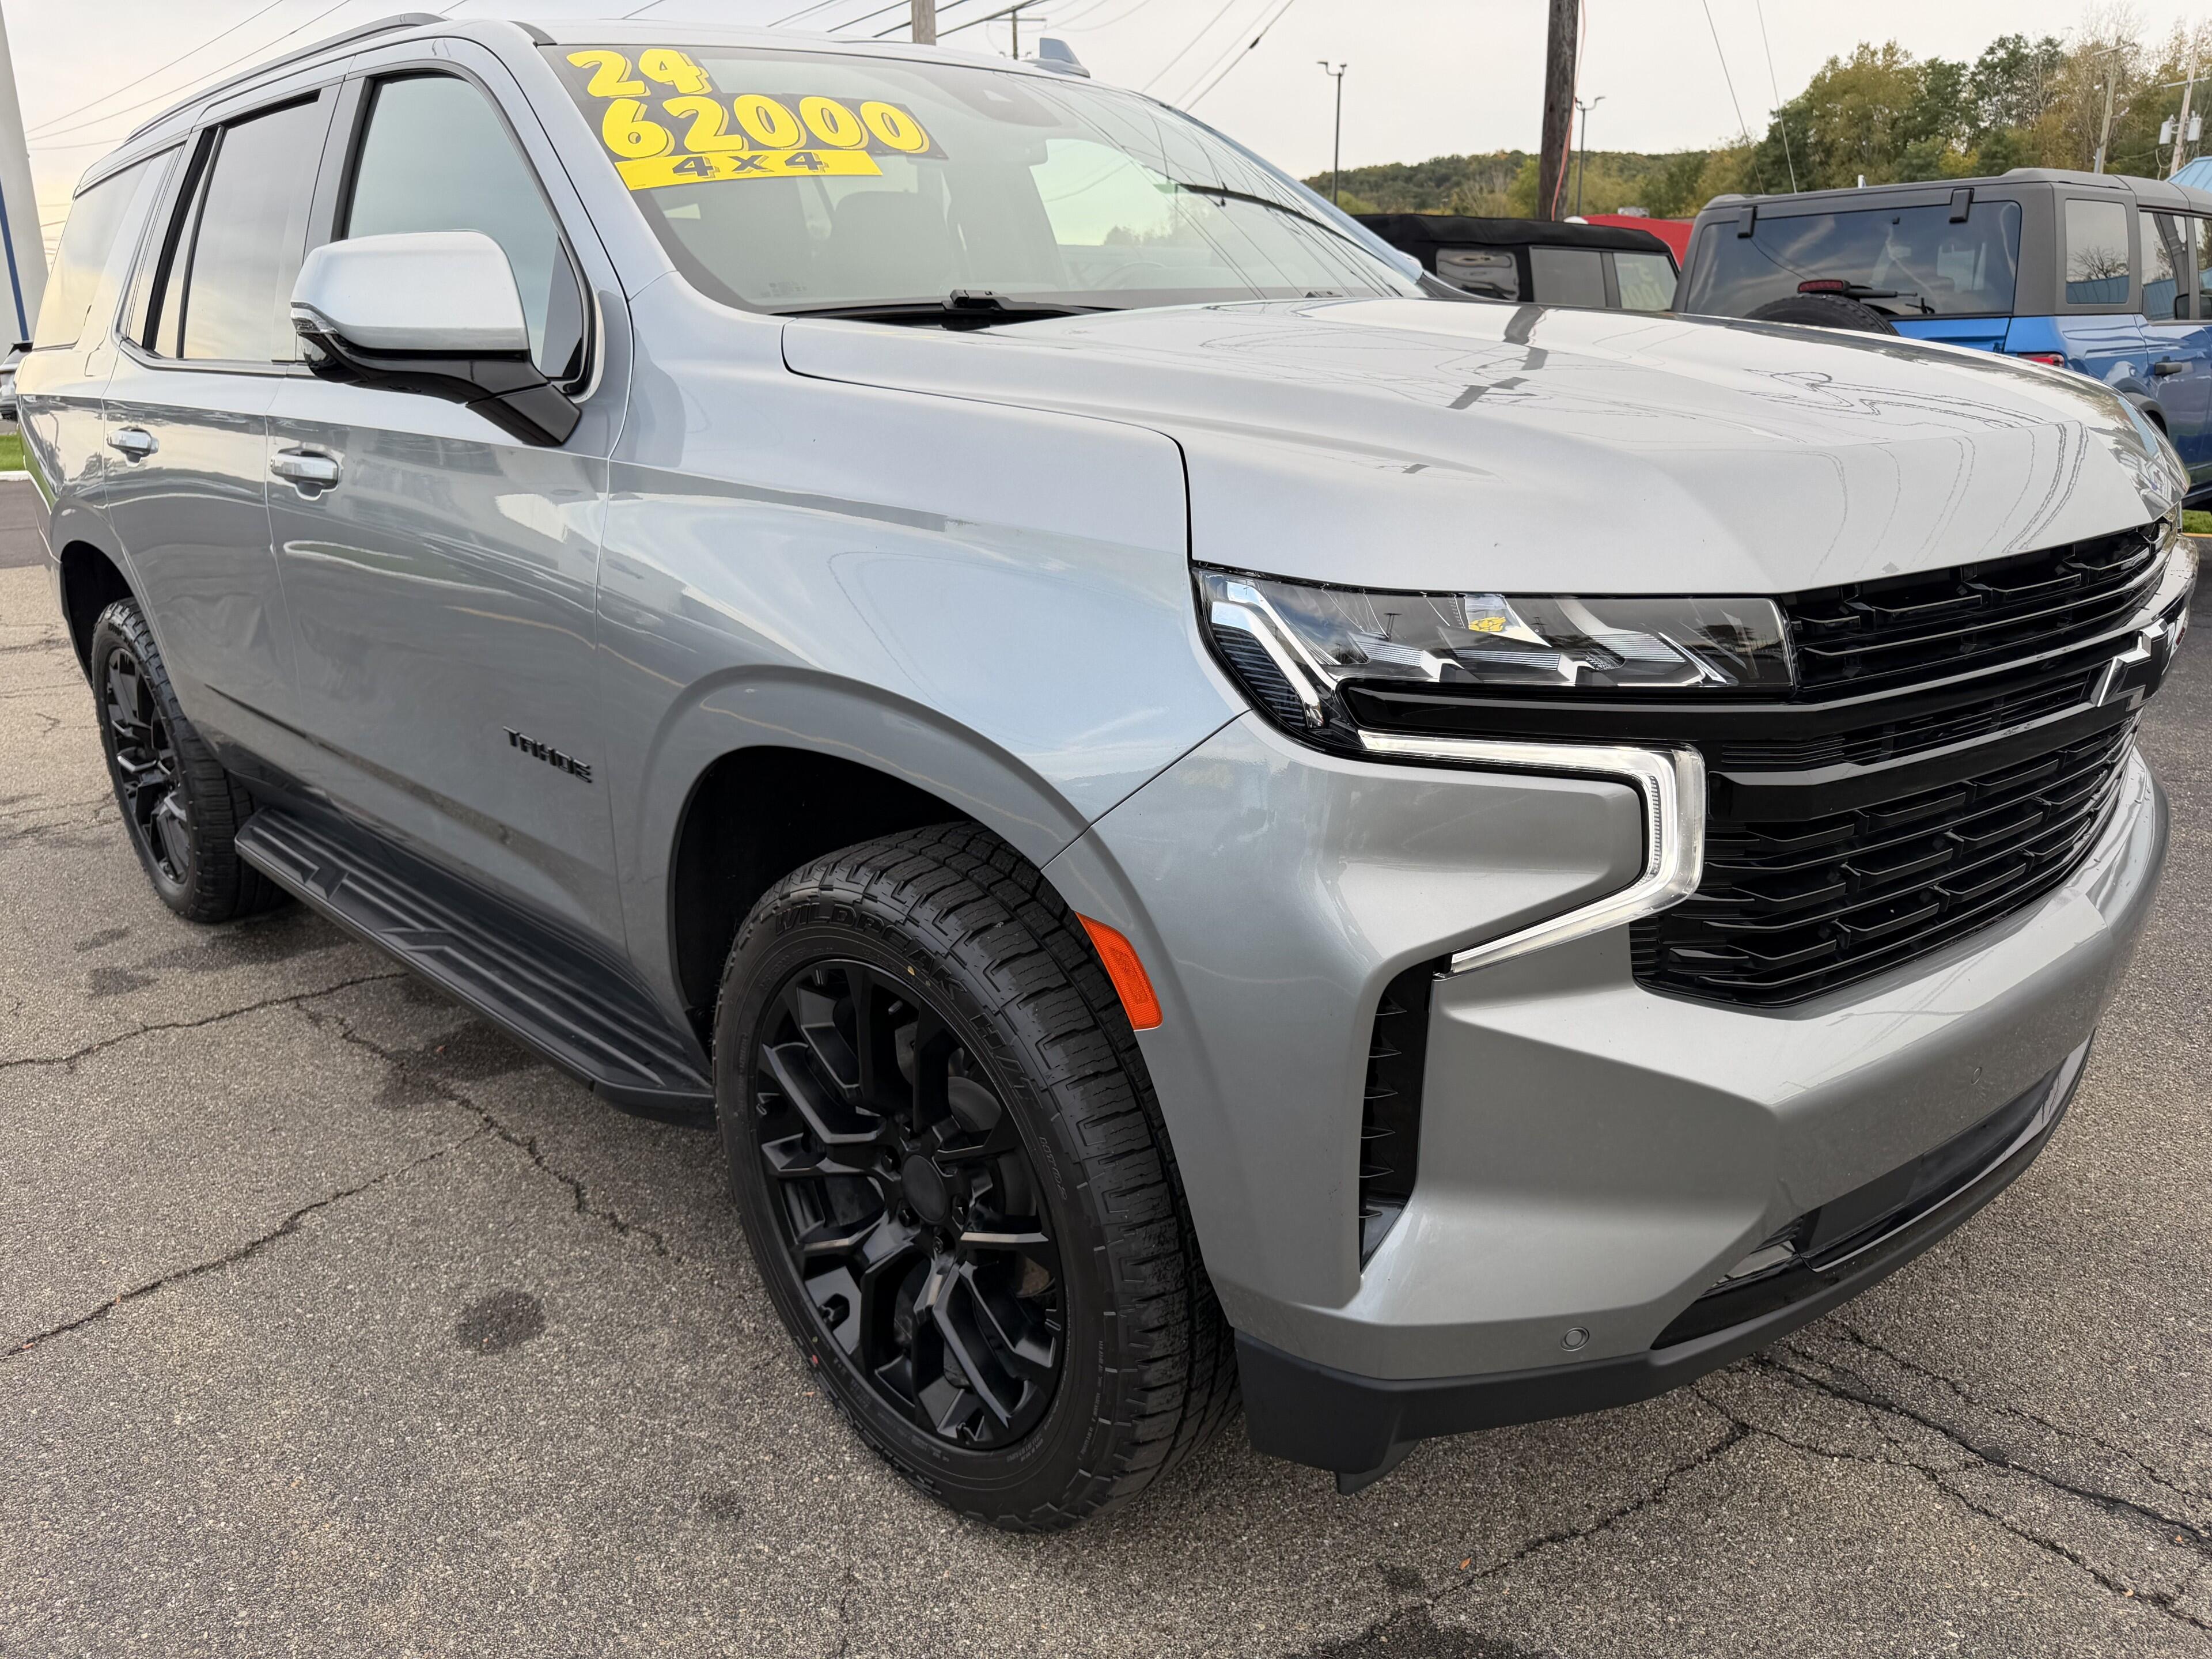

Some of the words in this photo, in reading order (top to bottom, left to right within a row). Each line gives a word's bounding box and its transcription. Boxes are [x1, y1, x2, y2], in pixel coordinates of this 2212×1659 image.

[566, 48, 712, 98] 24
[602, 94, 930, 160] 62000
[502, 725, 593, 783] TAHOE
[775, 902, 969, 1001] WILDPEAK
